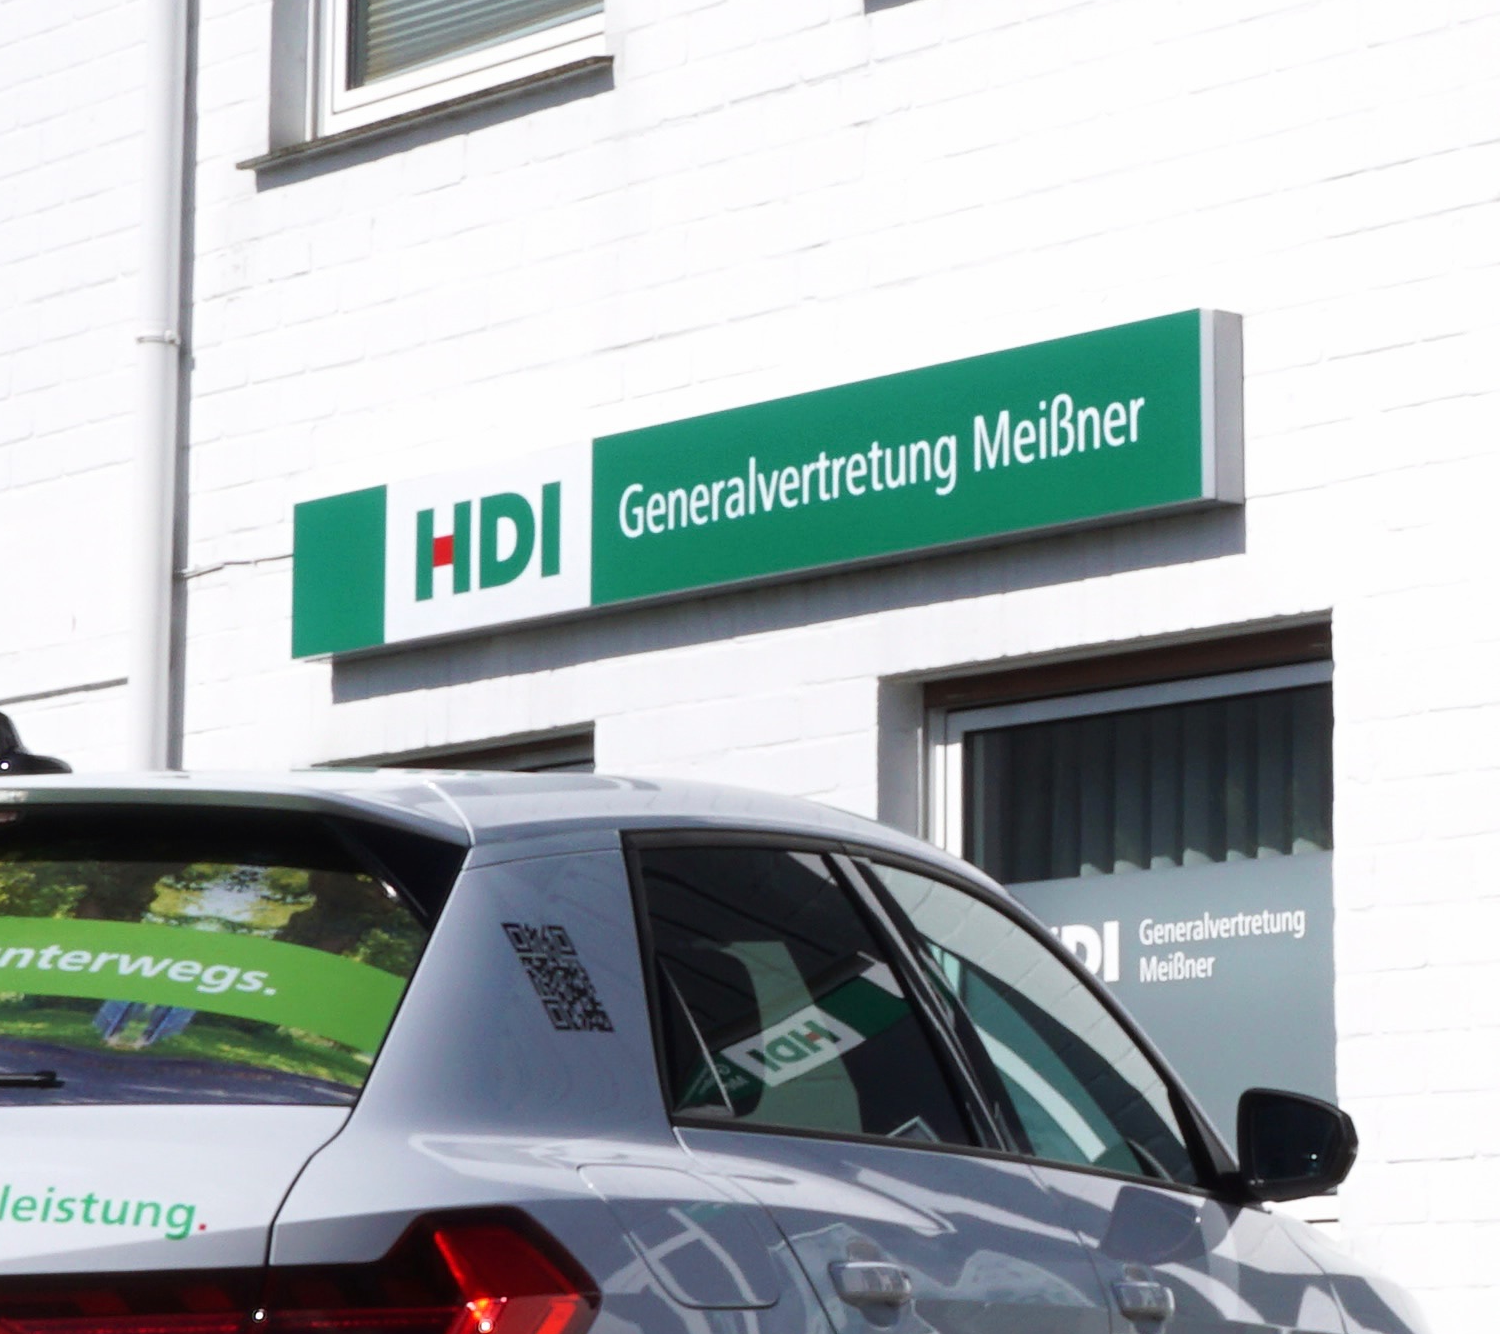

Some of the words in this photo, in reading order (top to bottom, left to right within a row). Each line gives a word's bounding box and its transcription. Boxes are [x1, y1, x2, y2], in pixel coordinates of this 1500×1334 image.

[416, 482, 561, 601] HDI
[618, 433, 957, 540] Generalvertretung
[973, 392, 1145, 473] Meißner
[1050, 920, 1120, 983] DI
[1138, 909, 1306, 946] Generalvertretung
[1139, 950, 1216, 983] Meißner
